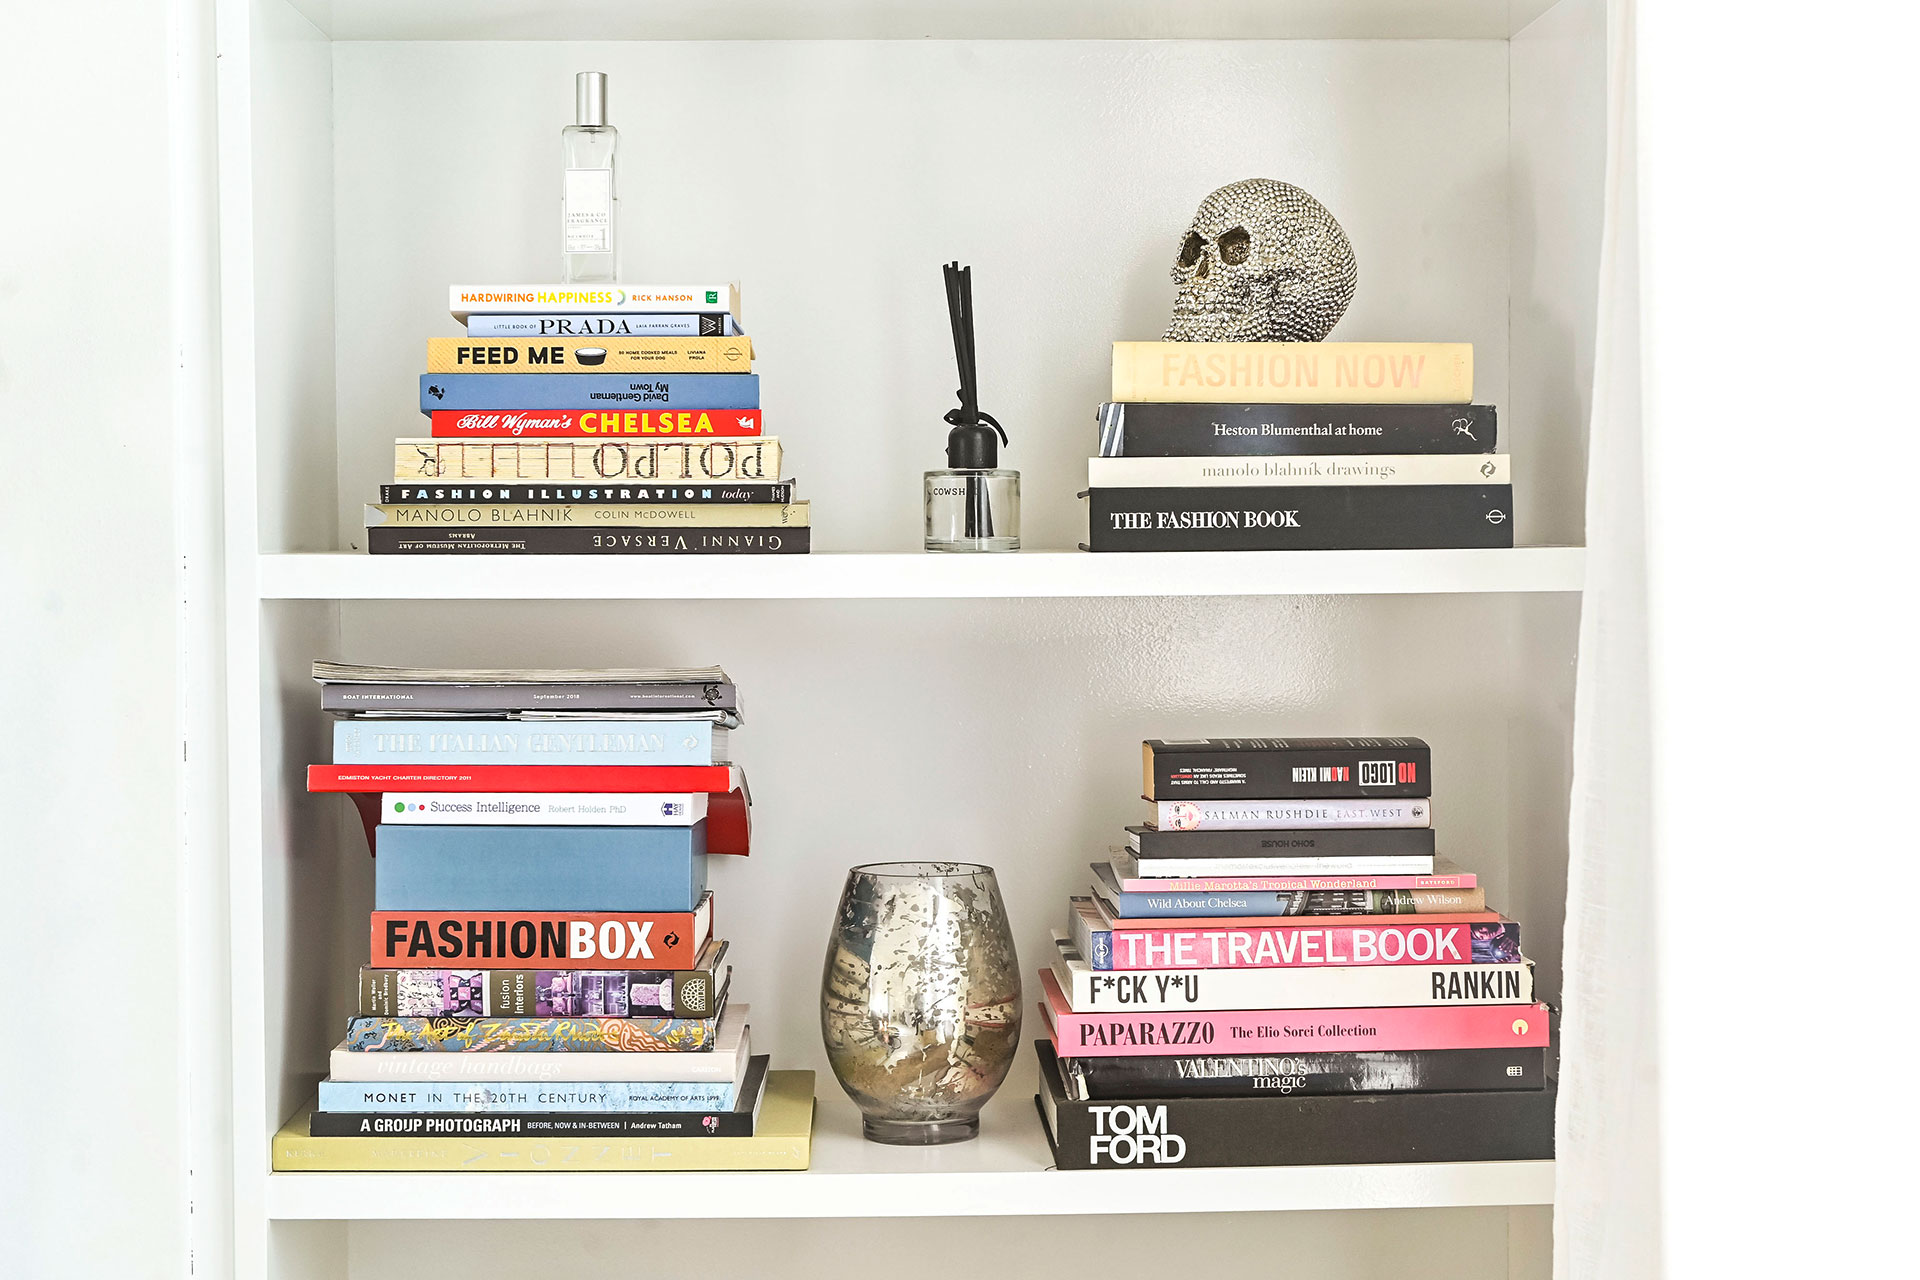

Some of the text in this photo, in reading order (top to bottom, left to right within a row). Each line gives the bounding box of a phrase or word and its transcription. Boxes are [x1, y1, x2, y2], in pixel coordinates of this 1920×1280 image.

[461, 292, 693, 303] HARDWIRING HAPPINESS RICK HANSON
[538, 319, 633, 335] PRADA
[457, 347, 564, 364] FEED ME
[1162, 354, 1425, 389] FASHION NOW
[630, 381, 669, 391] My Town
[590, 392, 669, 401] David Gentleman
[457, 413, 714, 436] Bill Wyman's CHELSEA
[1211, 422, 1383, 437] Heston Blumenthal at home
[1202, 464, 1260, 478] manolo
[1326, 461, 1396, 480] drawings
[401, 488, 754, 502] FASHION ILLUSTRATION today
[933, 488, 968, 496] COWSH
[396, 508, 695, 522] MANOLO BLAHNIK COLIN McDOWELL
[1110, 510, 1301, 529] THE FASHION BOOK
[593, 535, 783, 550] GIANNI VERSACE
[373, 732, 421, 753] THE
[429, 732, 519, 753] ITALIAN
[527, 732, 665, 753] GENTLEMAN
[1292, 766, 1350, 783] NAOMI KLEIN
[1361, 761, 1416, 784] NO LOGO
[430, 801, 541, 815] Success Intelligence
[548, 804, 627, 814] Robert Holden PhD
[1204, 809, 1328, 820] SALMAN RUSHDIE
[1291, 840, 1315, 848] SOHO
[1170, 879, 1377, 891] Millie Marotta's Tropical Wonderland
[1147, 897, 1248, 909] Wild About Chelsea
[1385, 894, 1462, 906] Andrew Wilson
[1120, 932, 1198, 966] THE
[1203, 928, 1347, 964] TRAVEL
[1352, 925, 1462, 963] BOOK
[1431, 971, 1521, 999] RANKIN
[500, 979, 510, 1009] fusion
[1079, 1021, 1215, 1046] PAPARAZZO
[1230, 1024, 1377, 1039] The Elio Sorci Collection
[377, 1056, 562, 1080] vintage handbags
[1174, 1056, 1307, 1079] VALENTINO's
[1252, 1074, 1307, 1095] magic
[364, 1093, 607, 1103] MONET IN THE 20TH CENTURY
[360, 1118, 521, 1132] A GROUP PHOTOGRAPH
[527, 1121, 620, 1130] BEFORE, NOW & IN-BETWEEN
[631, 1121, 681, 1129] Andrew Tatham
[1088, 1105, 1166, 1134] TOM
[1089, 1135, 1186, 1164] FORD
